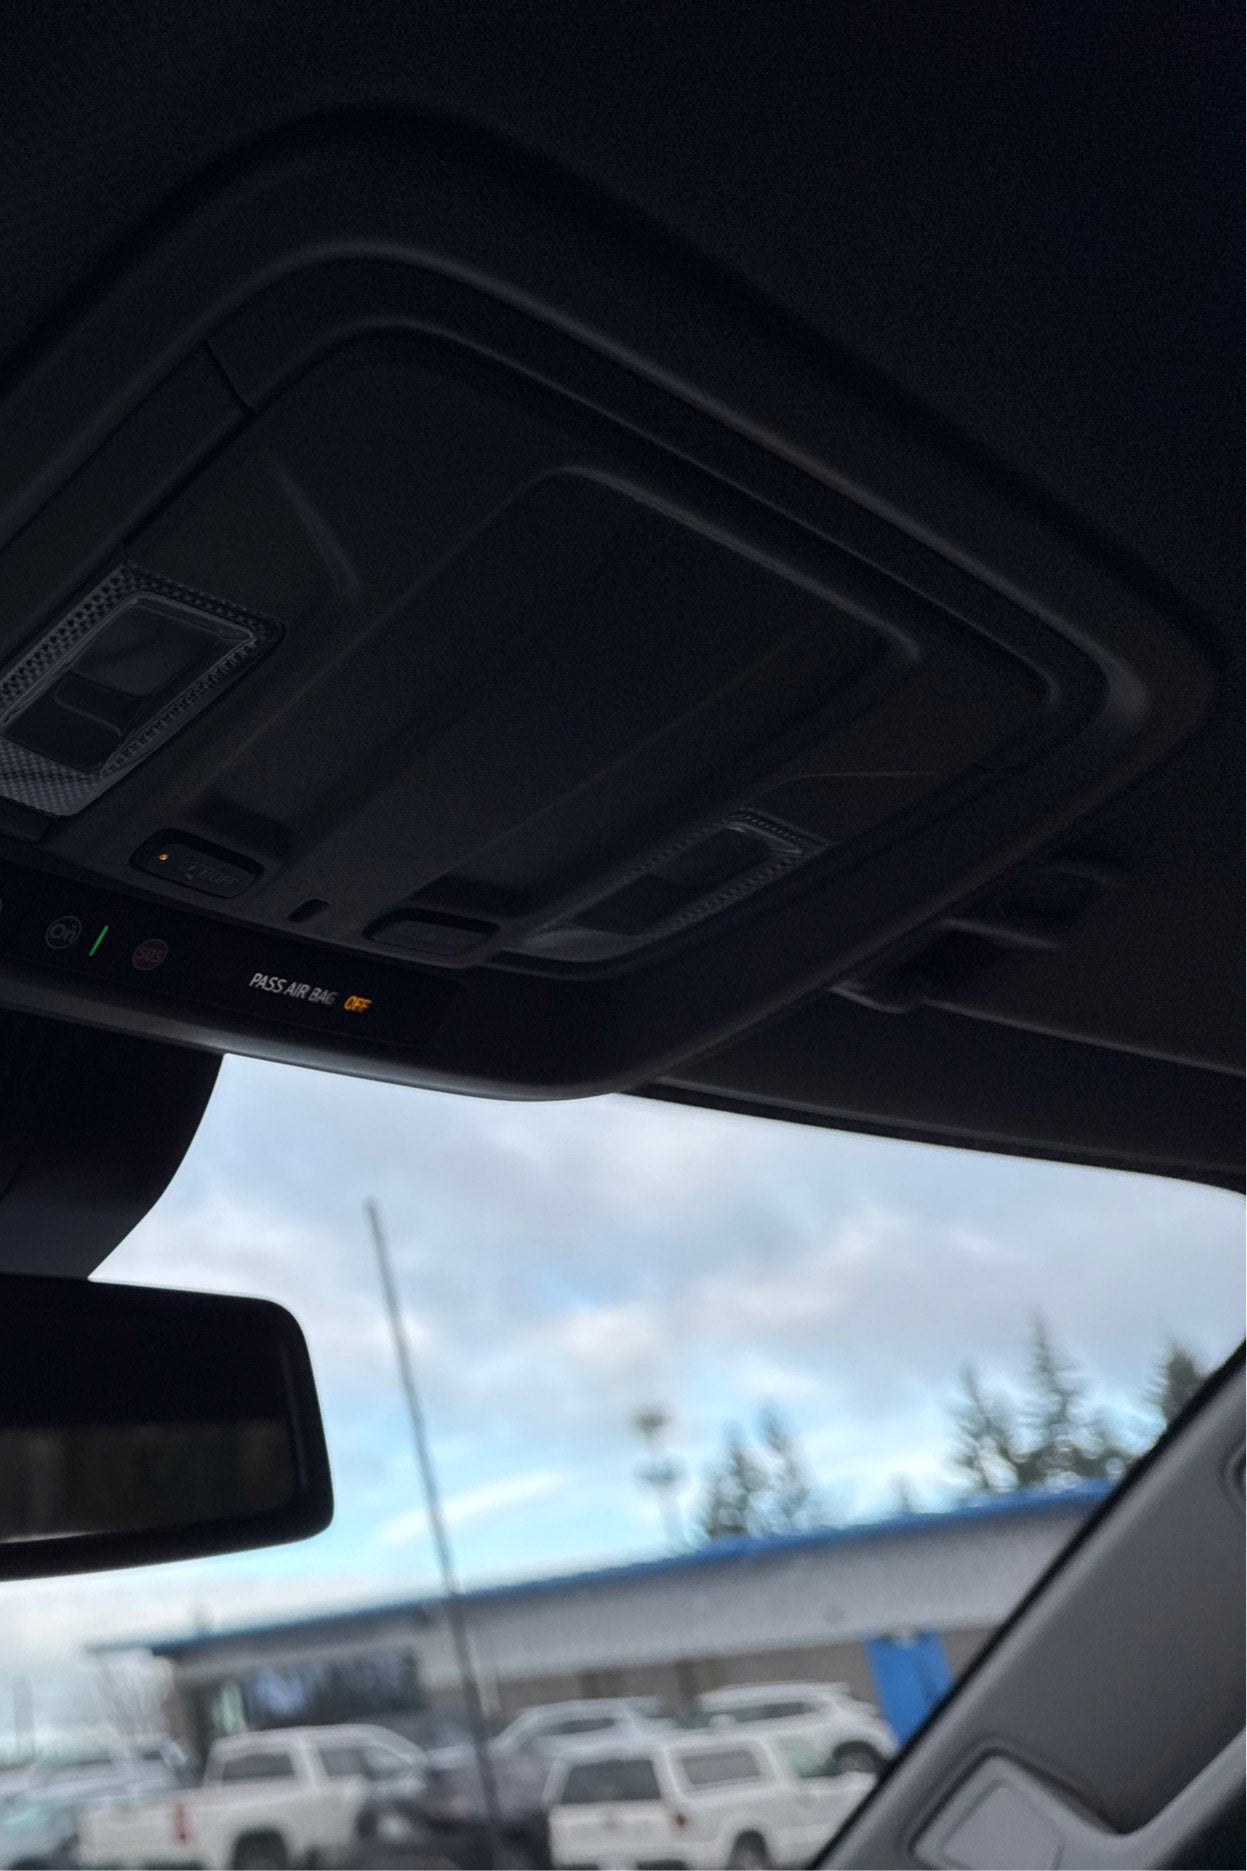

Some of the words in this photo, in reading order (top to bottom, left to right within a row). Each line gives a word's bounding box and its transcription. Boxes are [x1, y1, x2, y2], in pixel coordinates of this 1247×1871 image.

[208, 872, 240, 886] OFF
[135, 945, 164, 962] SOS
[248, 971, 288, 994] PASS
[282, 981, 312, 1000] AIR
[308, 986, 339, 1006] BAG
[343, 995, 373, 1013] OFF
